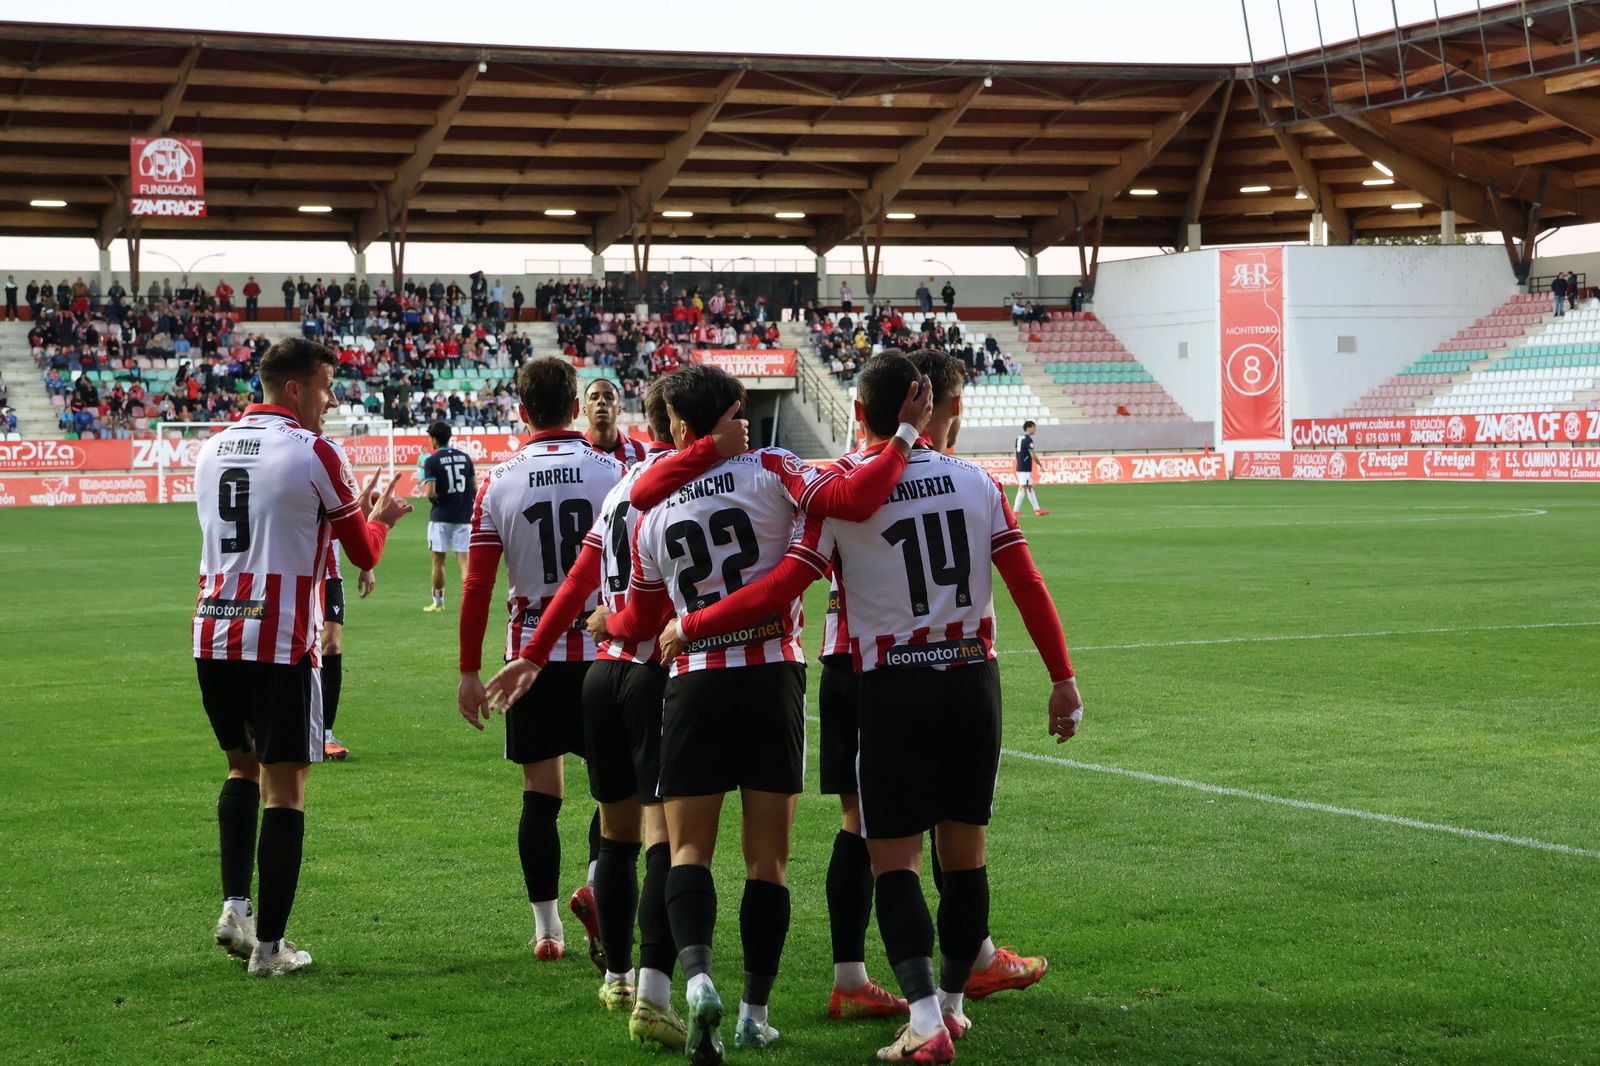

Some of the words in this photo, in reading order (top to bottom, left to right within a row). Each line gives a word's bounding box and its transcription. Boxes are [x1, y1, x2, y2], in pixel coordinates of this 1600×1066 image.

[140, 184, 197, 196] FUNDACIÓN
[1225, 324, 1279, 335] MONTETORO
[1247, 355, 1267, 384] 8
[1410, 417, 1446, 430] FUNDACIÓN
[1538, 412, 1561, 441] CF
[1367, 451, 1408, 470] Freigel
[1432, 451, 1476, 470] Freigel
[1521, 451, 1557, 467] CAMINO
[1559, 452, 1571, 467] DE
[1572, 452, 1583, 467] LA
[445, 463, 467, 494] 15
[529, 467, 584, 488] FARRELL
[1540, 468, 1552, 478] del
[678, 471, 736, 505] SANCHO
[218, 467, 251, 554] 9
[522, 499, 594, 584] 18
[665, 507, 760, 614] 22
[880, 508, 974, 618] 14
[886, 644, 985, 666] leomotor.net
